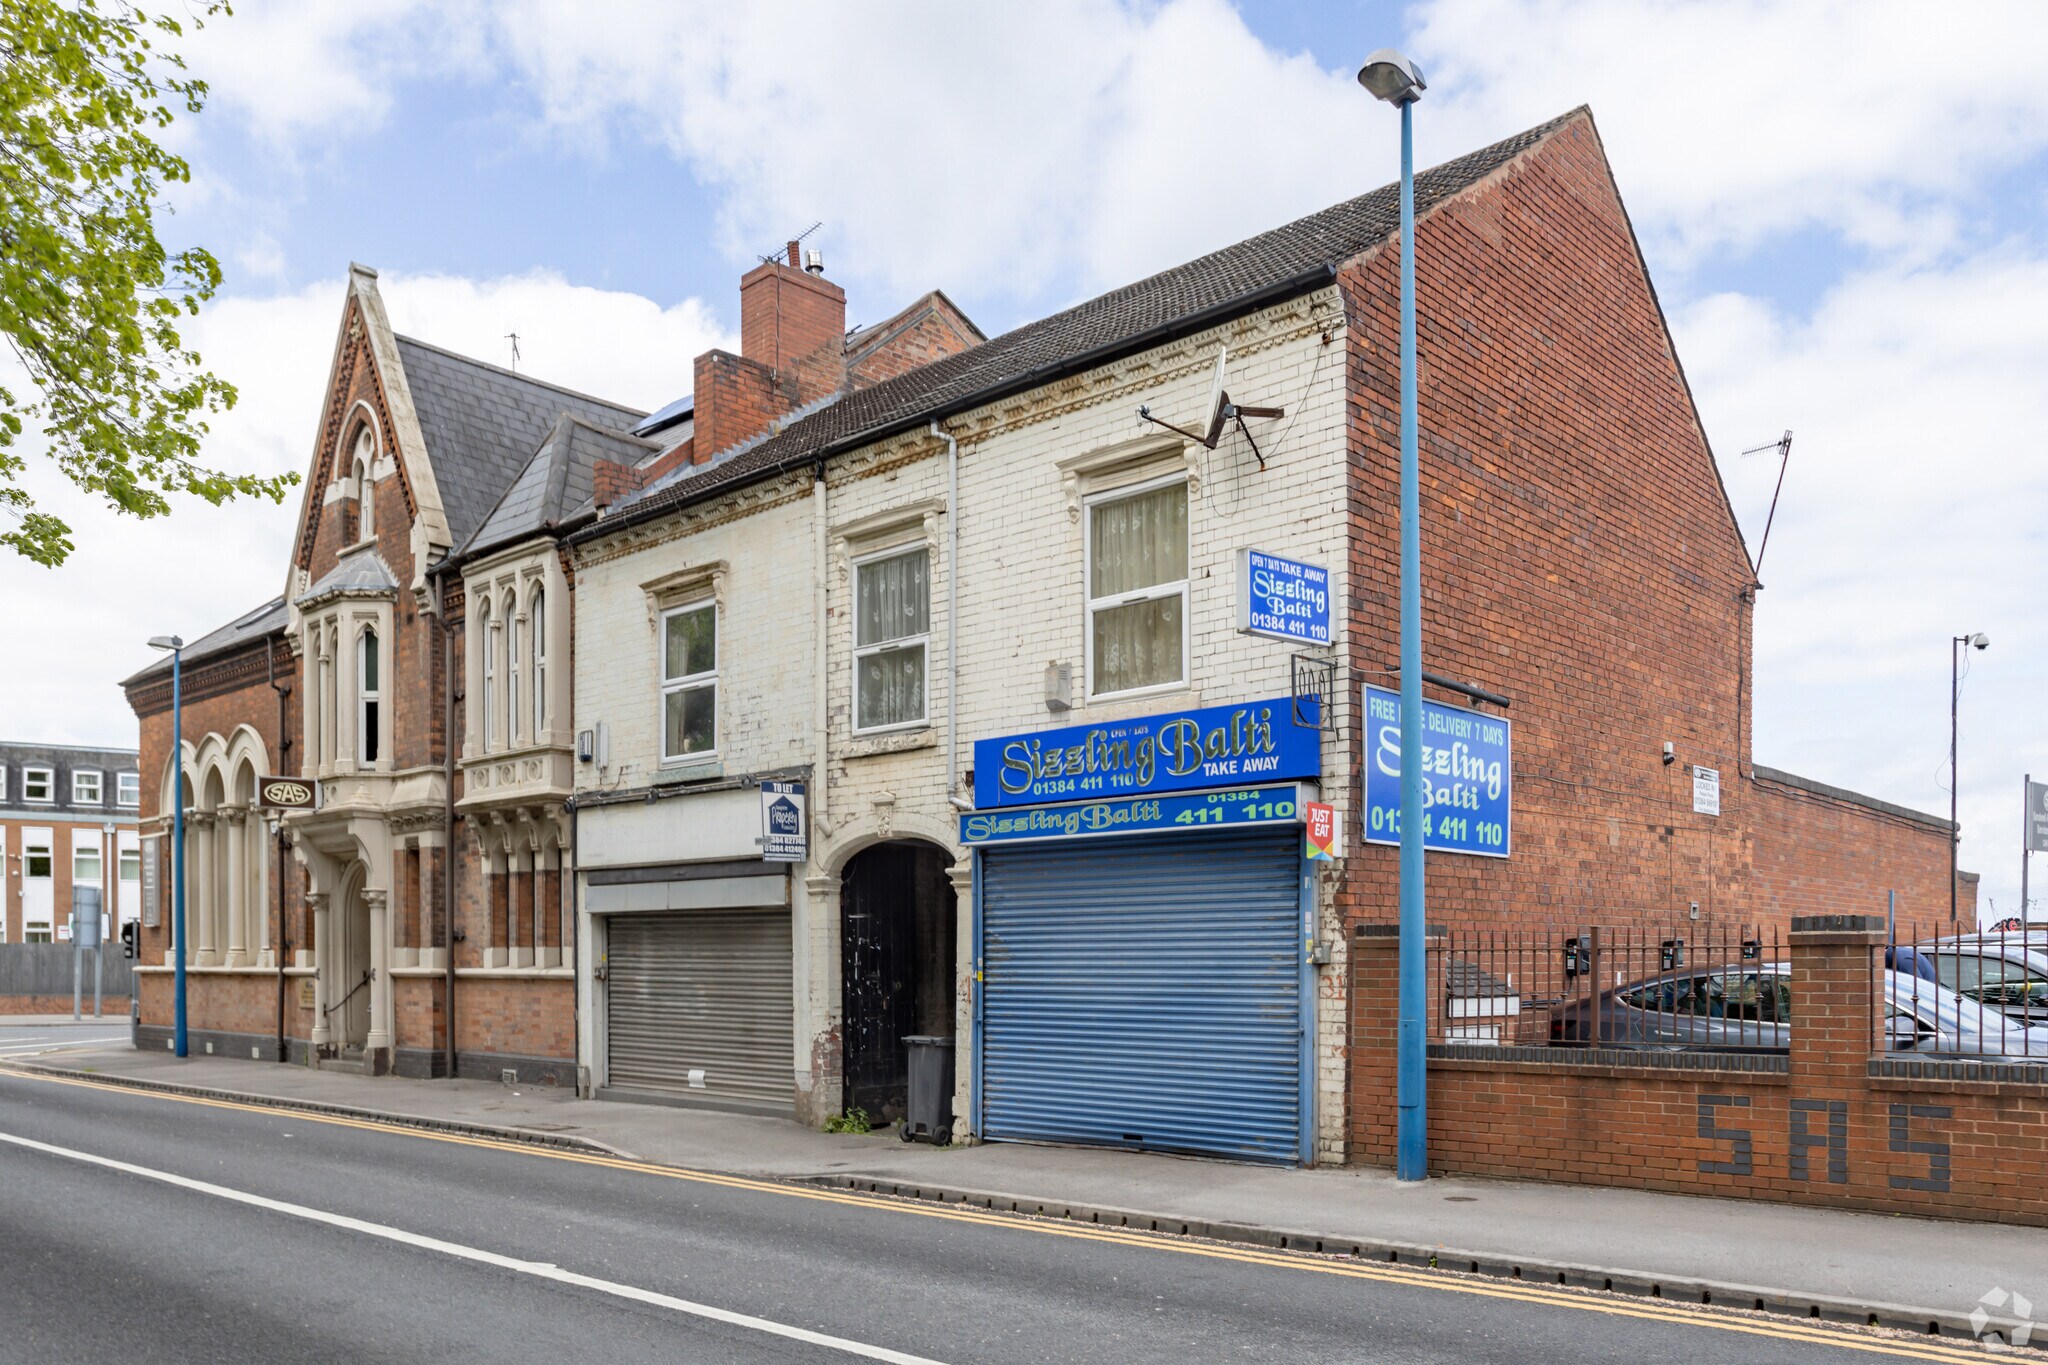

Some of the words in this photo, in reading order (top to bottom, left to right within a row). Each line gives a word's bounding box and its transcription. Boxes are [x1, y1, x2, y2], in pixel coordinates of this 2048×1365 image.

[1251, 554, 1264, 568] OPEN
[1268, 558, 1280, 571] DAYS
[1280, 561, 1302, 577] TAKE
[1304, 568, 1325, 583] AWAY
[1253, 569, 1325, 613] Sizzling
[1266, 596, 1312, 618] Balti
[1251, 612, 1285, 631] 01384
[1289, 619, 1305, 635] 411
[1310, 624, 1327, 639] 110
[1370, 696, 1396, 722] FREE
[1429, 712, 1472, 739] DELIVERY
[1475, 723, 1480, 741] 7
[1483, 724, 1503, 746] DAYS
[1000, 729, 1155, 795] Sizzling
[1156, 708, 1276, 776] Balti
[1376, 725, 1501, 800] Szzling
[1203, 759, 1238, 776] TAKE
[1243, 756, 1280, 773] AWAY
[270, 785, 305, 802] SAS
[773, 782, 782, 792] TO
[783, 783, 793, 793] LET
[1033, 778, 1075, 796] 01384
[1080, 775, 1103, 790] 411
[1110, 773, 1134, 787] 110
[1207, 790, 1260, 803] 01384
[1080, 800, 1163, 830] Balti
[1175, 806, 1223, 824] 411
[1242, 801, 1294, 819] 110
[1311, 808, 1330, 823] JUST
[1314, 823, 1330, 837] EAT
[1371, 805, 1432, 837] 014
[1439, 815, 1467, 841] 411
[1476, 821, 1502, 846] 110
